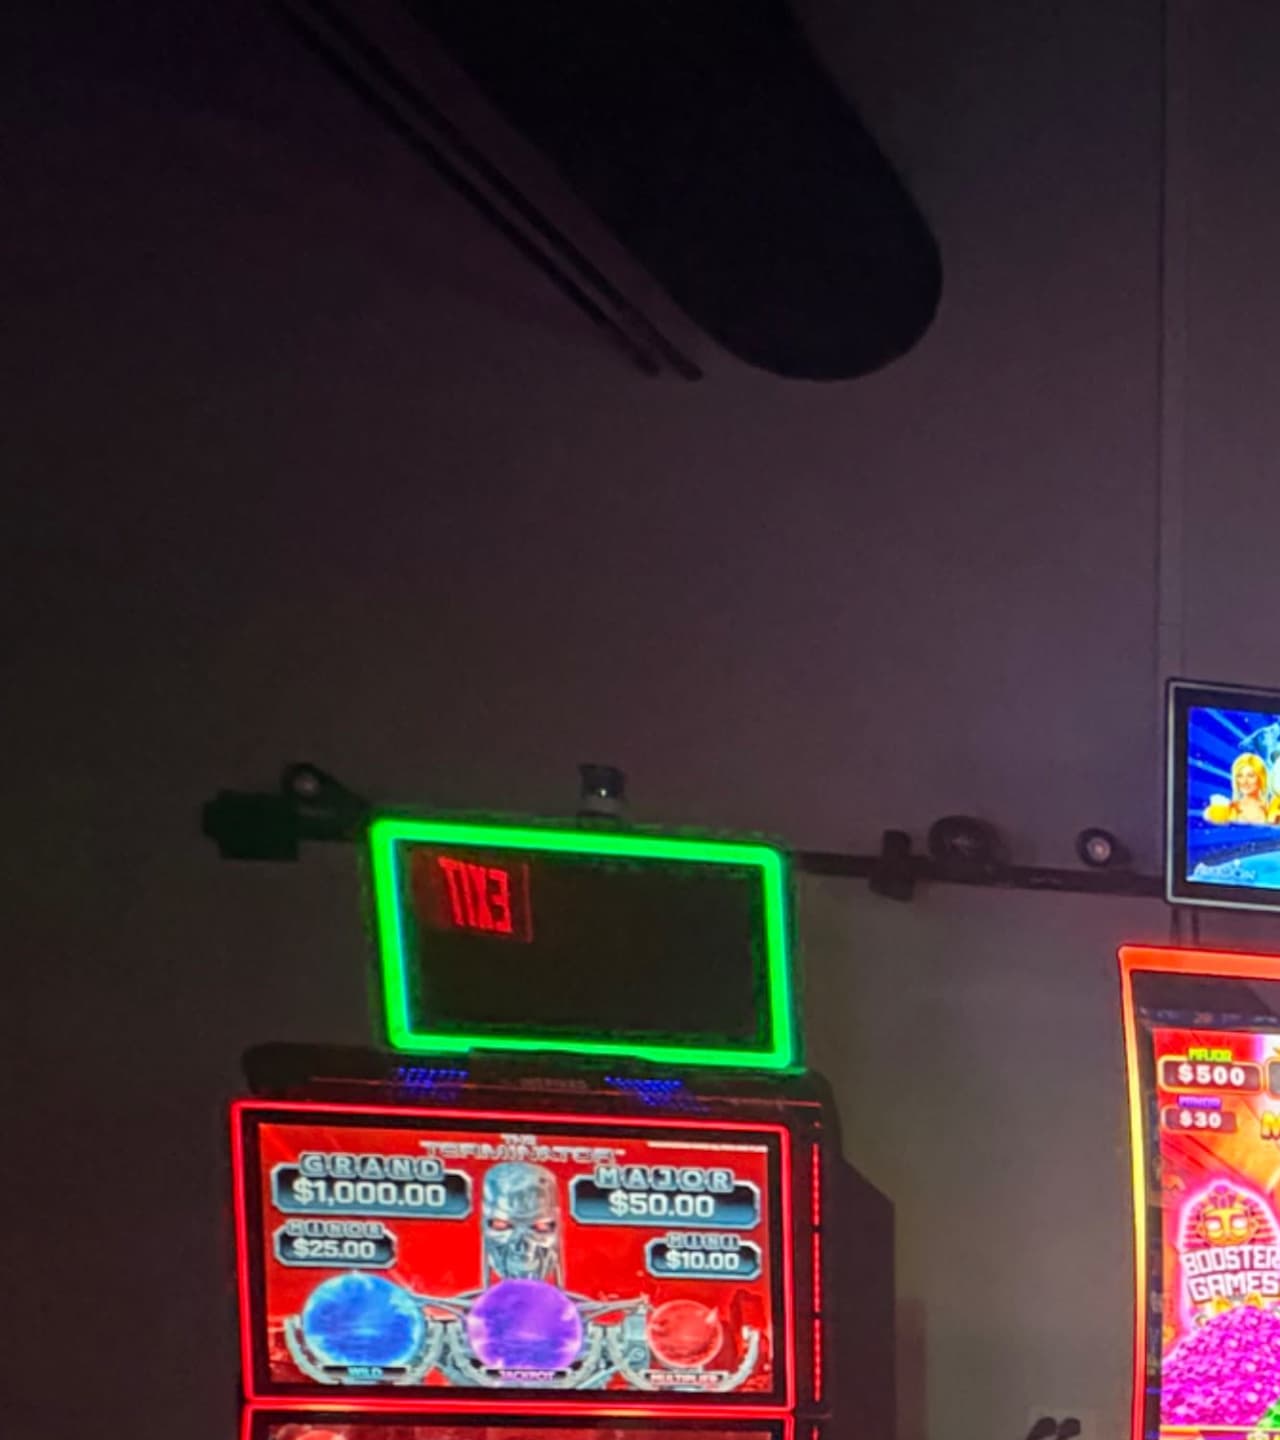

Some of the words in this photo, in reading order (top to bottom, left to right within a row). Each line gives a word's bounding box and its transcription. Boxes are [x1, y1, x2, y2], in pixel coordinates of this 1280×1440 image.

[1178, 1063, 1245, 1086] $500
[1179, 1112, 1222, 1128] $30
[302, 1155, 441, 1178] GRAND
[598, 1168, 732, 1191] MAJOR
[293, 1178, 447, 1206] $1,000.00
[609, 1190, 715, 1217] $50.00
[293, 1238, 376, 1259] $25.00
[665, 1250, 740, 1270] $10.00
